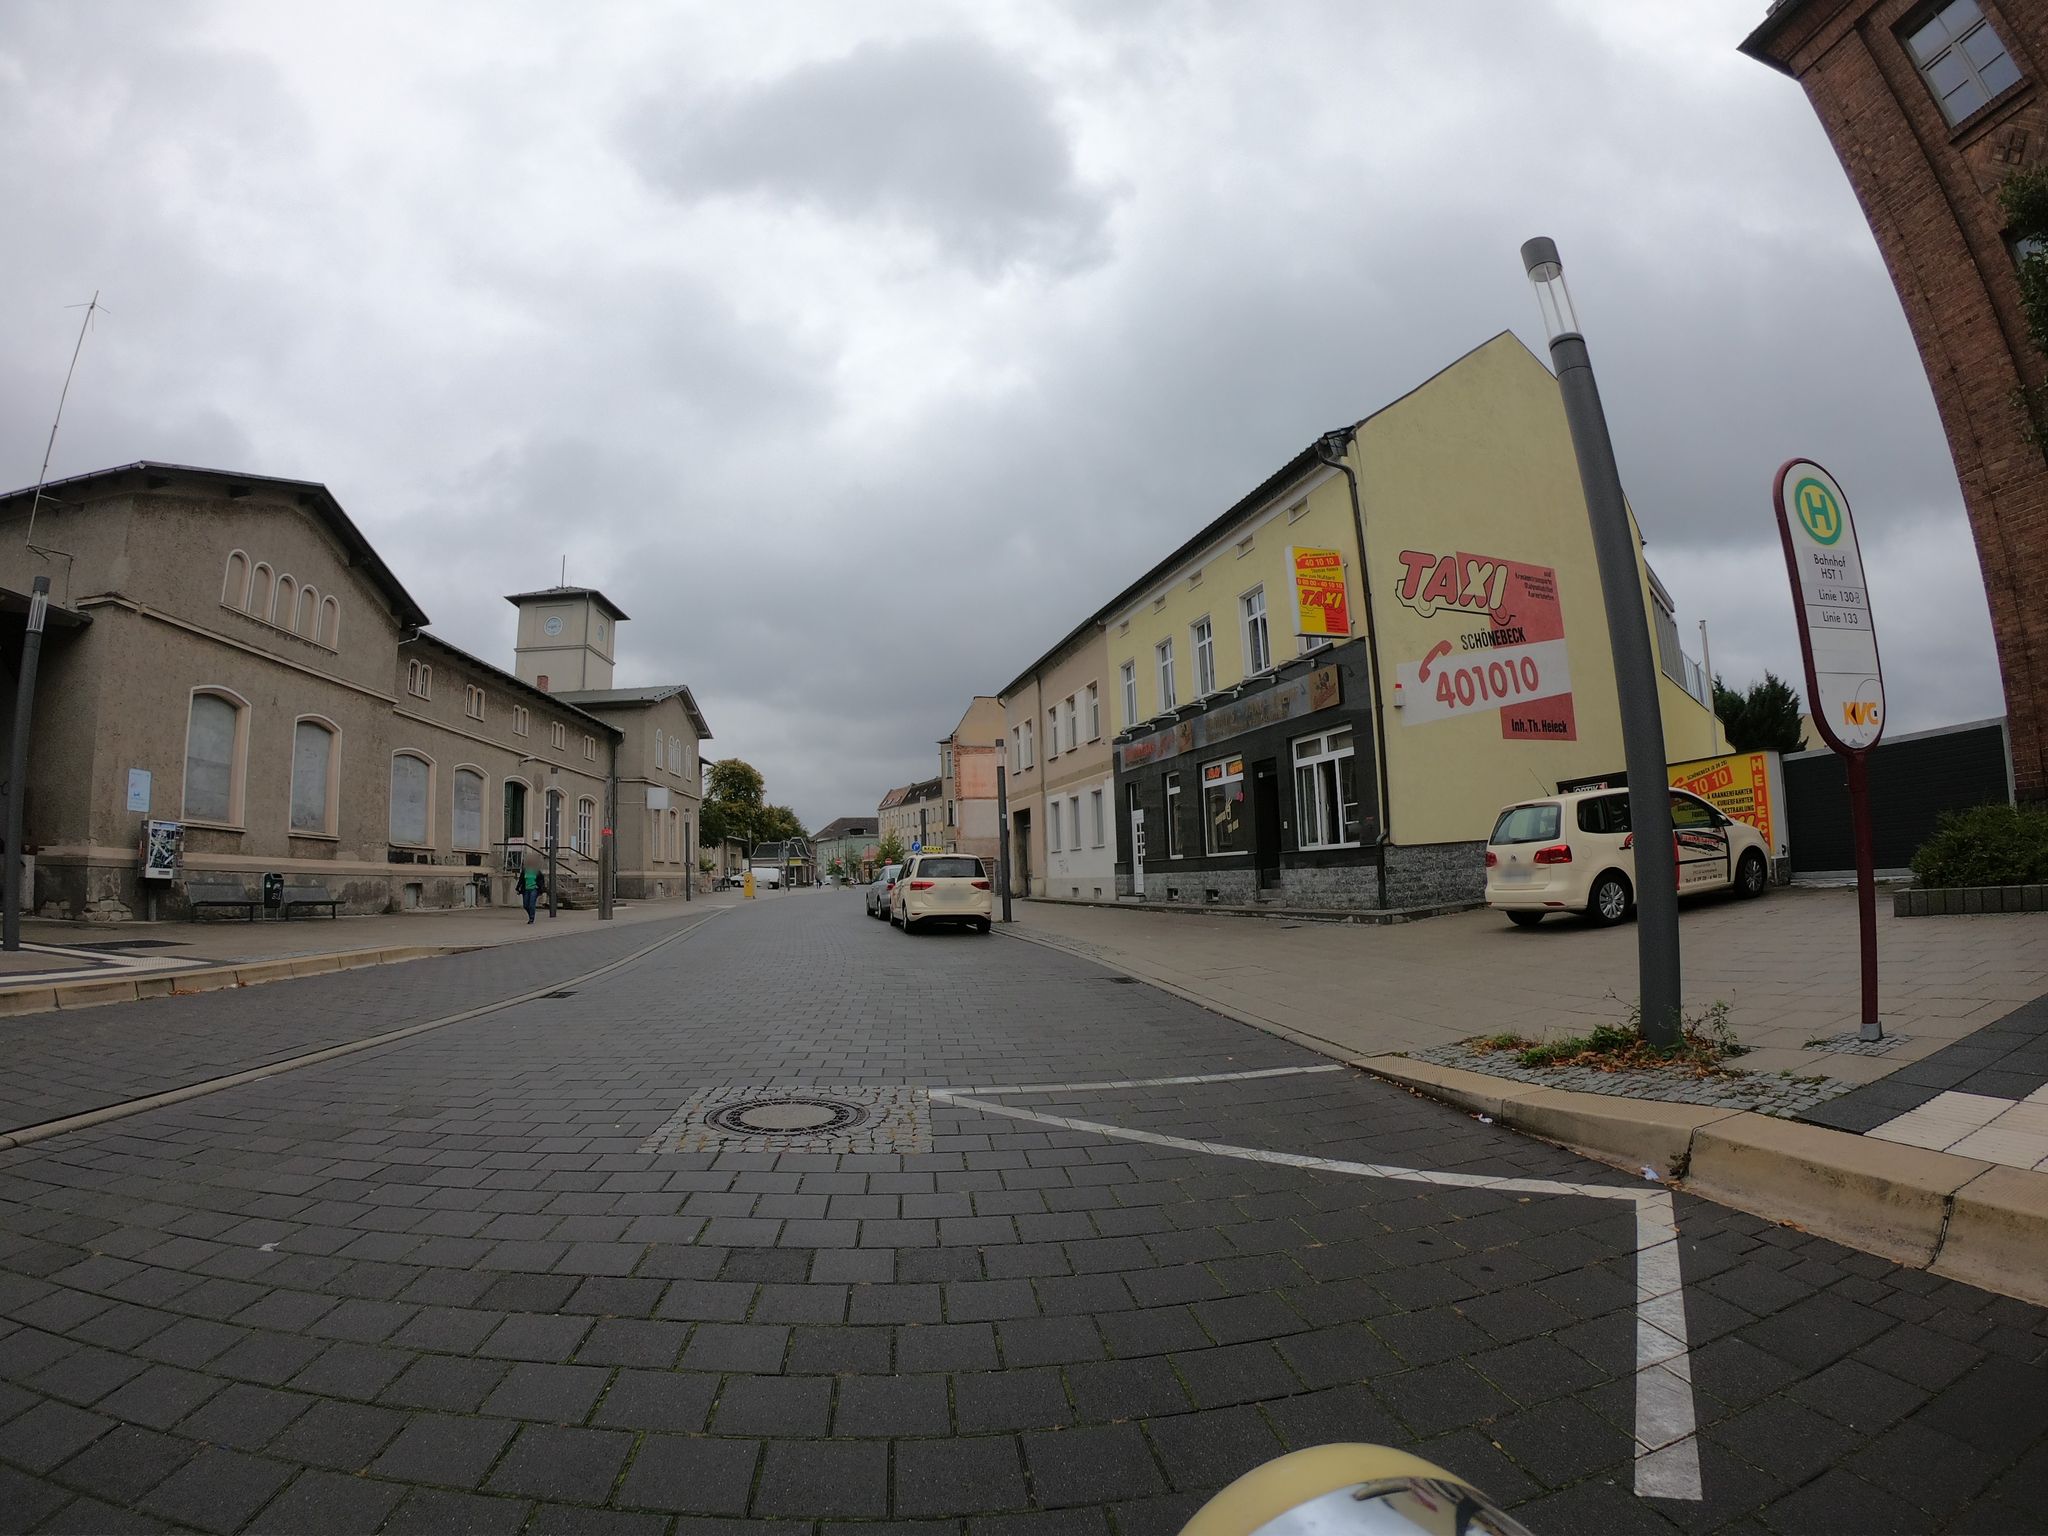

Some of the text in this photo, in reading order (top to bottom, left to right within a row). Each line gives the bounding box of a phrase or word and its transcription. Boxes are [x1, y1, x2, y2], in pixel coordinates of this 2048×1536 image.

[1805, 492, 1833, 531] H
[1814, 553, 1846, 568] Bahnhof
[1399, 550, 1509, 611] TAXI
[1820, 568, 1836, 580] HST
[1301, 589, 1342, 609] TAXI
[1818, 588, 1837, 601] Linie
[1822, 610, 1858, 624] Linie 133
[1460, 626, 1526, 650] SCHÖNEBECK
[1436, 656, 1539, 708] 401010
[1842, 702, 1878, 726] KVG
[1511, 718, 1568, 733] Inh. Th. Heieck
[1693, 770, 1728, 795] 10 10
[1712, 788, 1753, 799] KRANKENFAHRTEN
[1717, 797, 1754, 806] KURIERFAHRTEN
[1751, 758, 1769, 843] HEIEC
